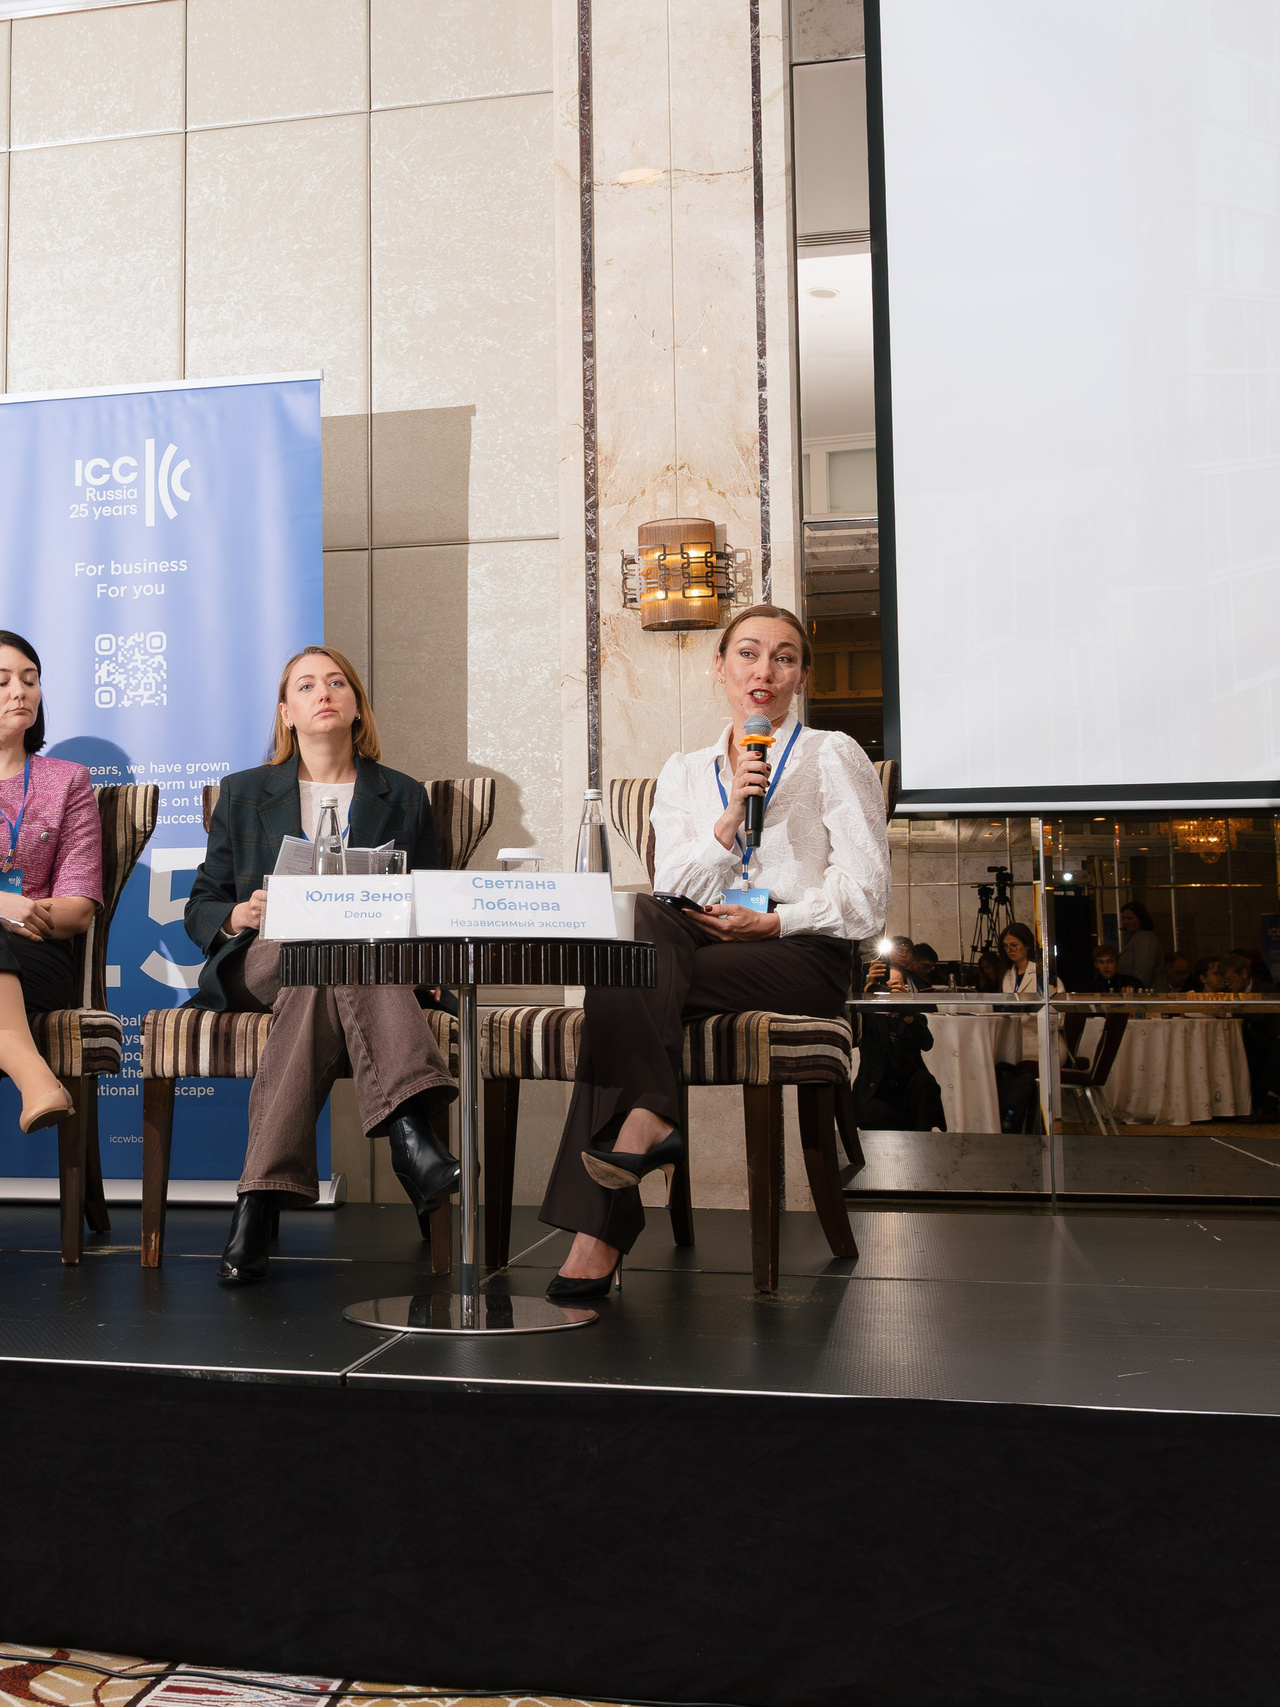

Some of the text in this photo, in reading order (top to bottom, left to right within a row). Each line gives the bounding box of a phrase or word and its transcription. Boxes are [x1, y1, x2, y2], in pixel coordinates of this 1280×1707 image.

[74, 455, 138, 487] ICC
[86, 485, 138, 502] Russia
[69, 503, 138, 520] 25 years
[74, 558, 188, 577] For business
[96, 583, 165, 599] For you
[87, 761, 230, 777] ears, we have grown
[172, 797, 189, 807] on
[156, 814, 204, 825] succes
[472, 876, 556, 890] Светлана
[306, 890, 355, 902] Юлия
[472, 898, 561, 912] Лобанова
[344, 910, 383, 919] Denuo
[450, 918, 586, 930] Независимый эксперт
[97, 1084, 139, 1096] tional
